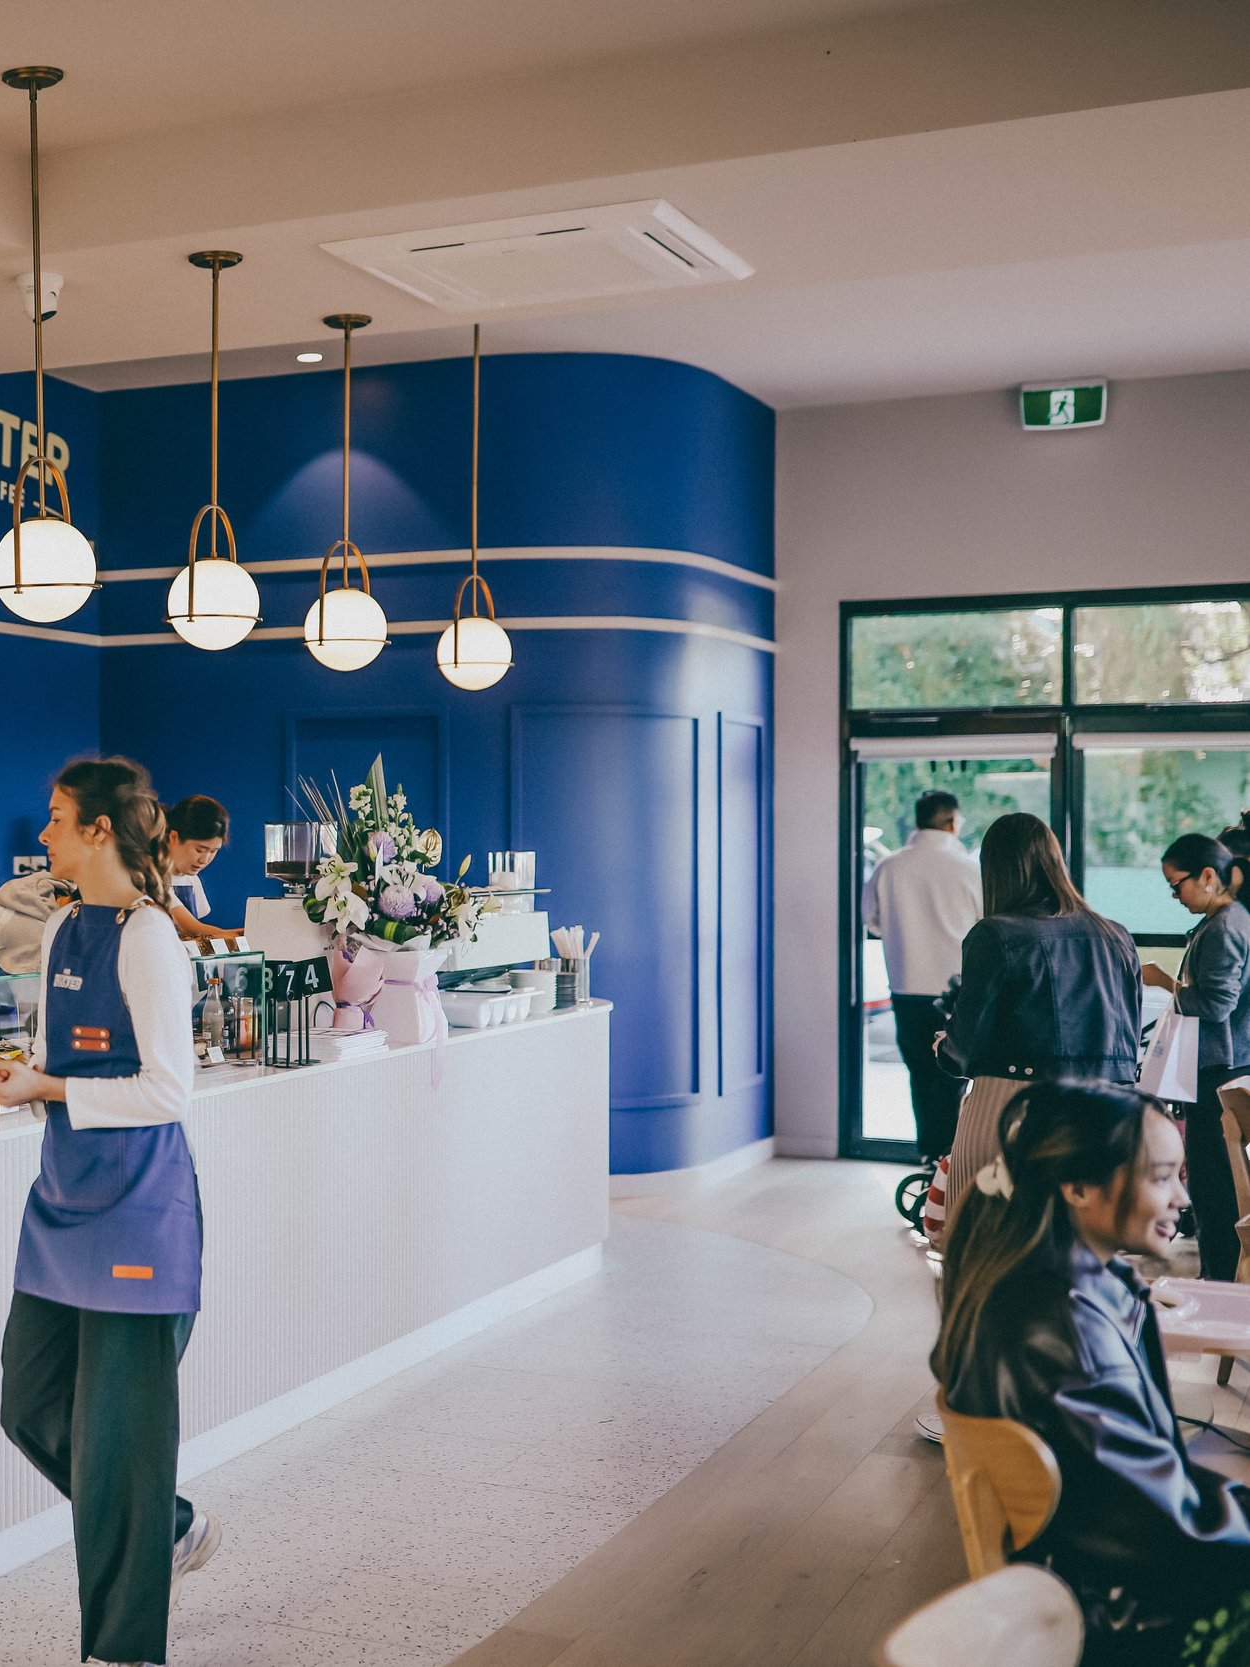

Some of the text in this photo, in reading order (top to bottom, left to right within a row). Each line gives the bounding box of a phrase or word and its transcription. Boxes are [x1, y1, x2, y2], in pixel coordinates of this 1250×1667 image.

[234, 966, 249, 991] 6
[285, 970, 296, 993] 7
[304, 963, 320, 989] 4
